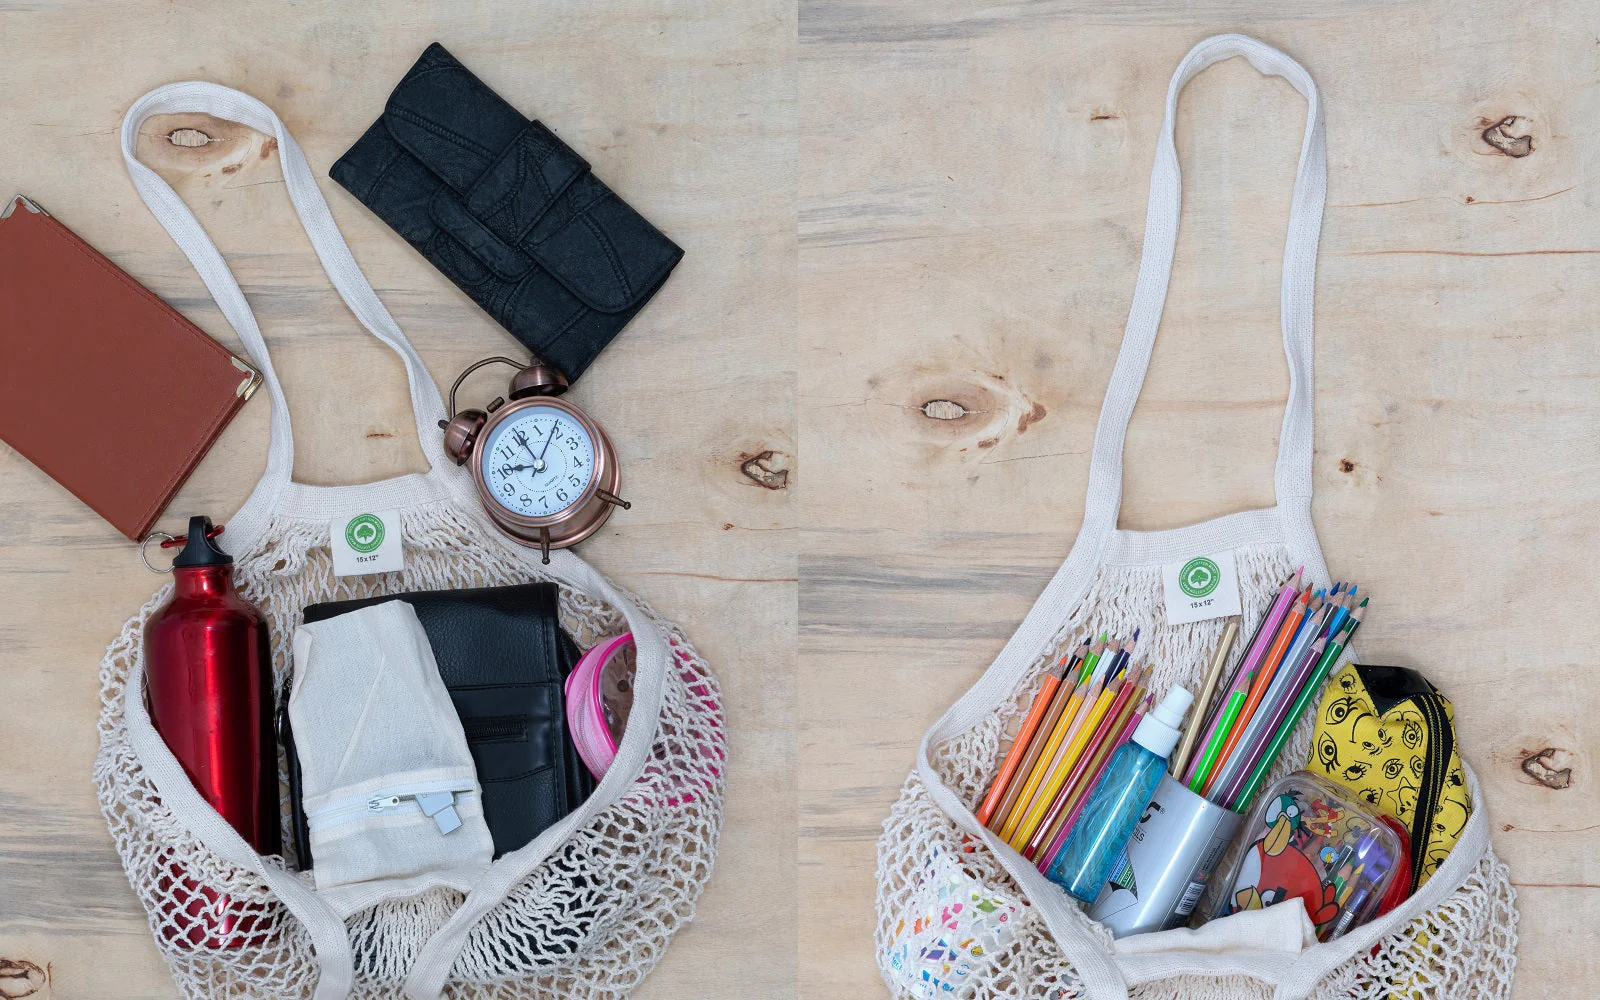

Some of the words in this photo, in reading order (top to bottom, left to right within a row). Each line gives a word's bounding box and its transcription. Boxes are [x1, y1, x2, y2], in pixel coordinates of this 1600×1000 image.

[533, 425, 543, 437] 1
[551, 426, 563, 440] 2
[512, 430, 530, 447] 12
[566, 437, 579, 451] 3
[500, 445, 516, 461] 11
[573, 456, 584, 468] 4
[497, 463, 514, 480] 10
[568, 474, 581, 487] 5
[503, 483, 516, 497] 9
[556, 488, 568, 502] 6
[520, 494, 532, 507] 8
[539, 495, 549, 509] 7
